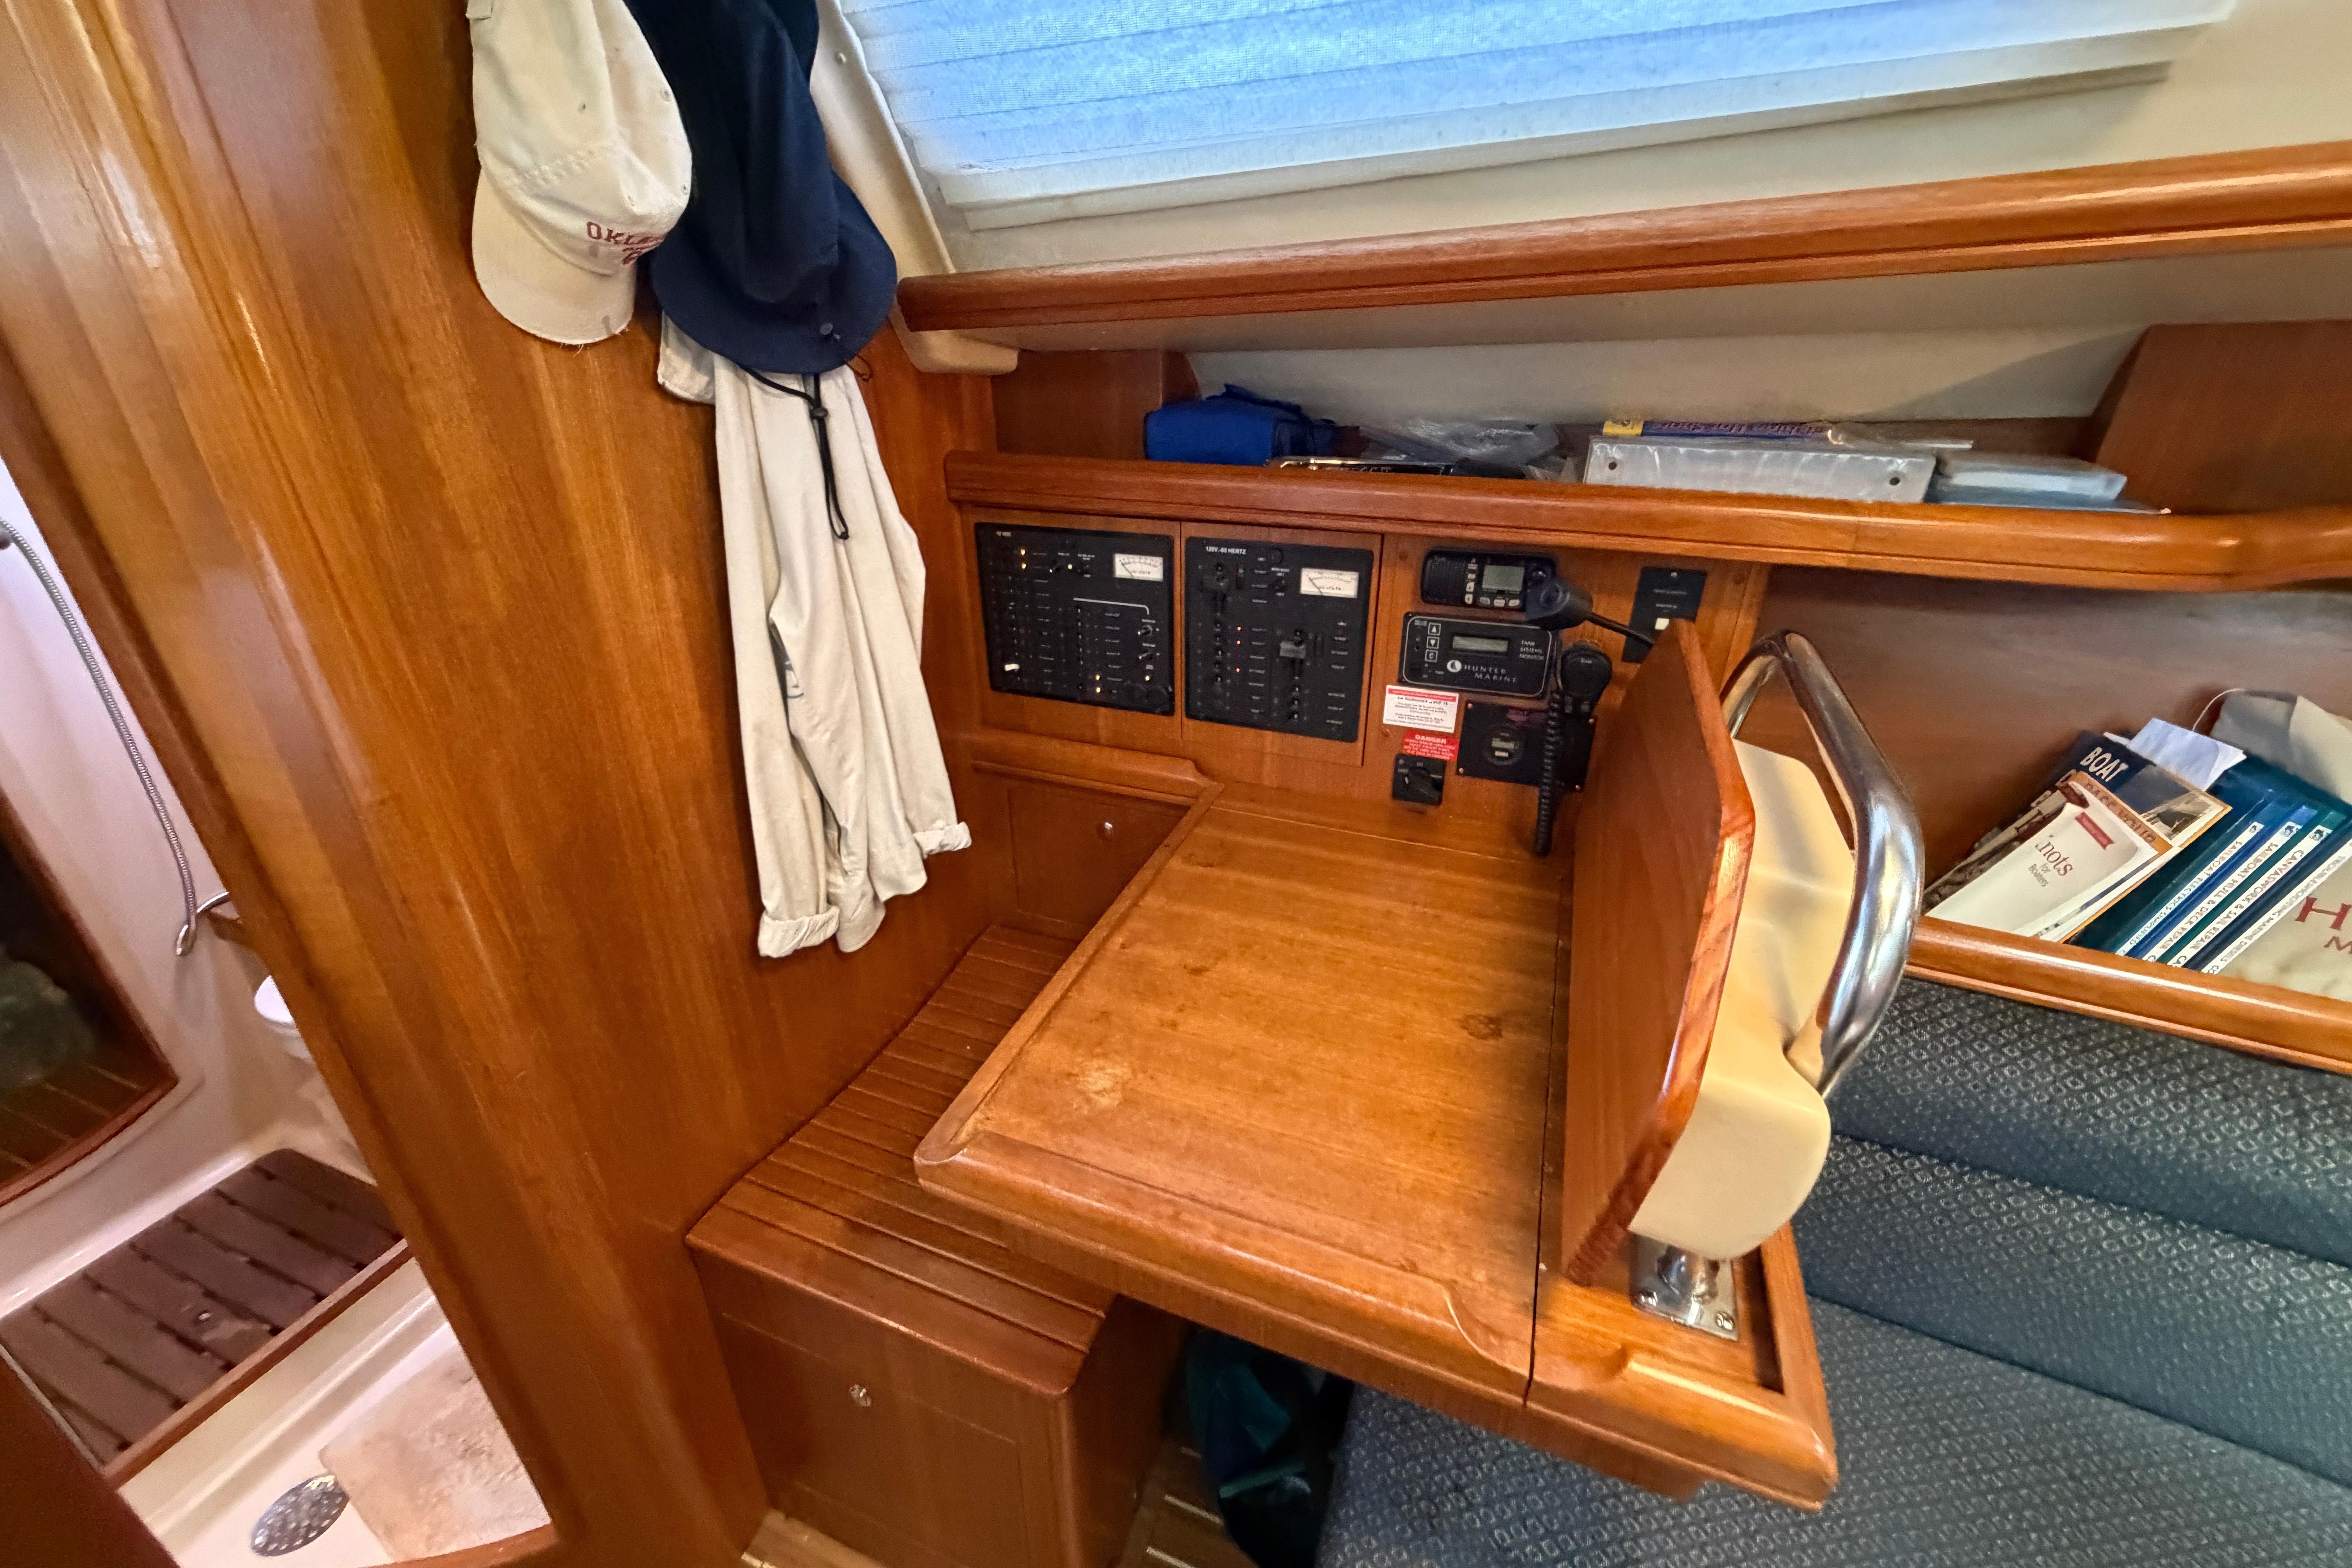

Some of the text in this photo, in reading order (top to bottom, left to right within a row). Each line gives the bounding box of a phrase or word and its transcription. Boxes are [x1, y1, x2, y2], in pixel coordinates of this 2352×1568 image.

[1464, 664, 1507, 674] HUNTER
[1475, 672, 1517, 683] MARINE
[1415, 734, 1447, 744] DANGER
[2080, 747, 2129, 782] BOAT
[2203, 840, 2242, 876] SAILBOAT
[2237, 842, 2278, 879] SAILBOAT
[2242, 850, 2305, 904] CANVASWORK
[2214, 879, 2238, 898] HULL
[2184, 906, 2209, 926] DECK
[2217, 910, 2237, 926] SAIL
[2189, 926, 2220, 950] REPAIR
